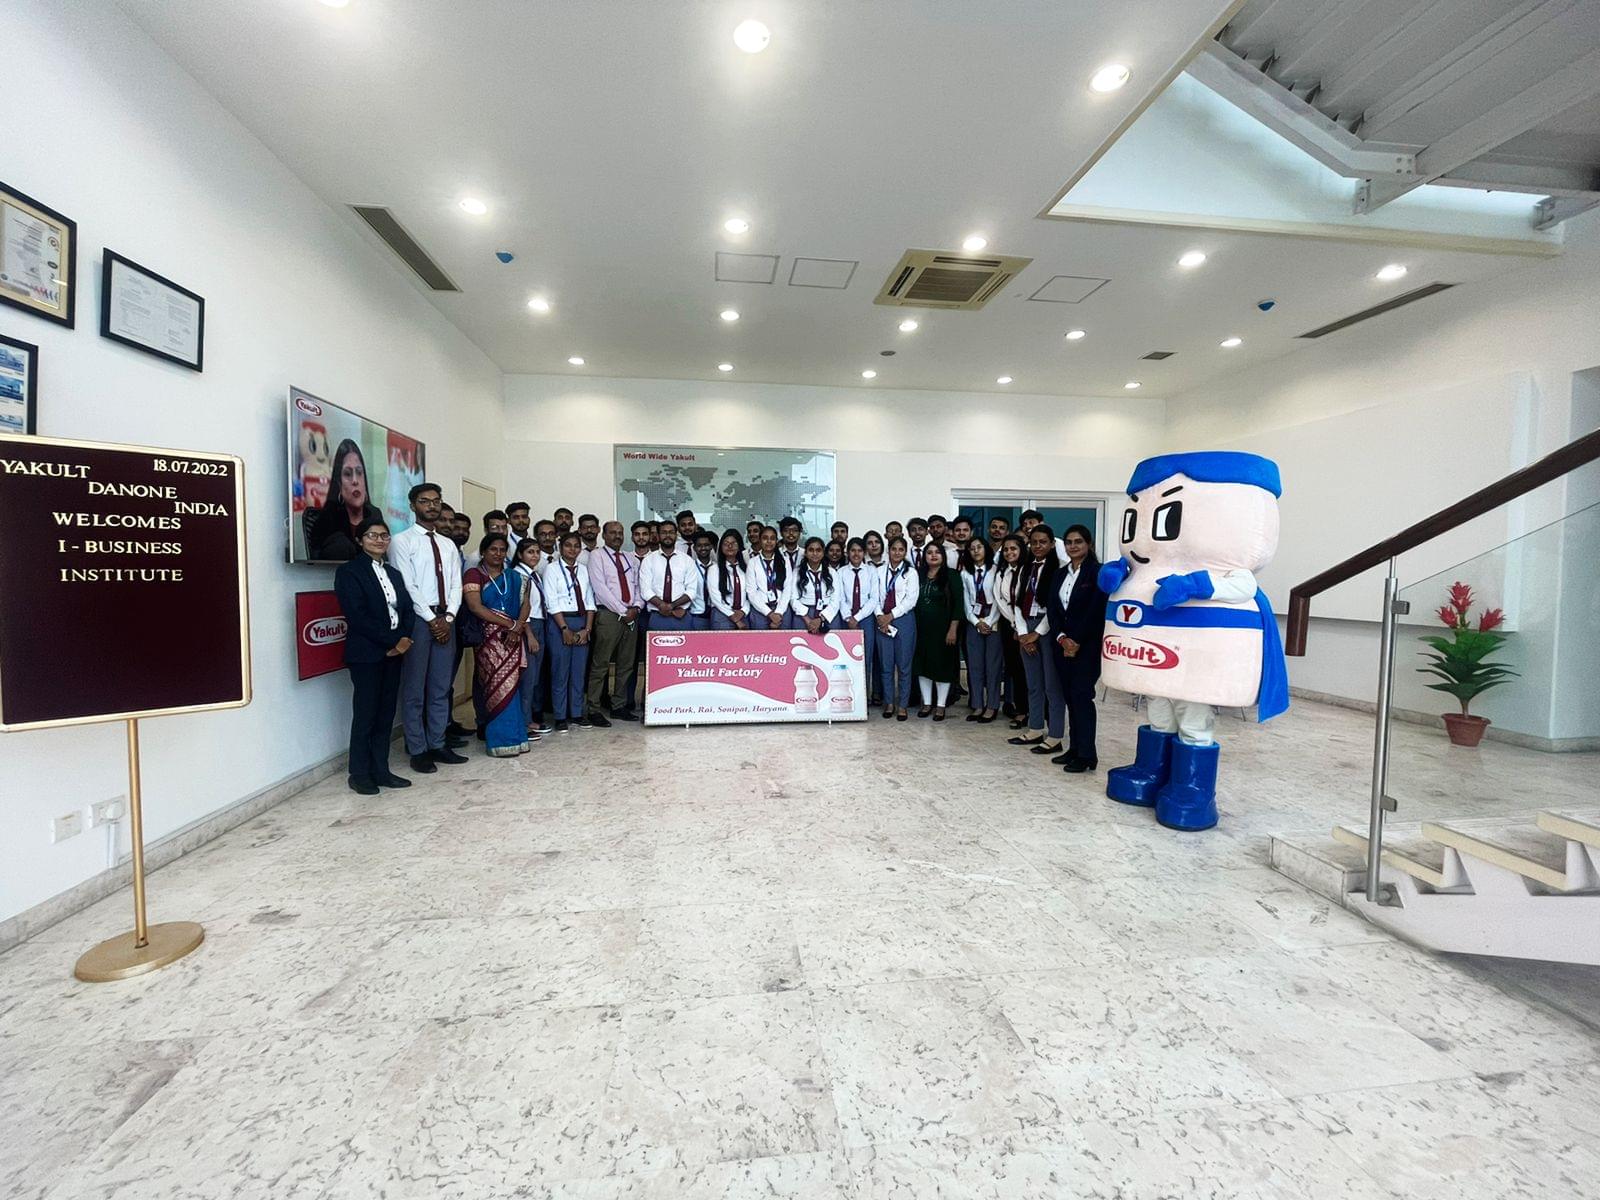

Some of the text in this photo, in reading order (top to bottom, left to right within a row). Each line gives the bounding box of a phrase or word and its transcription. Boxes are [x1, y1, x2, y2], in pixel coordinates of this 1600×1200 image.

[623, 452, 646, 460] World
[670, 453, 695, 461] Yakult
[0, 459, 91, 479] YAKULT
[153, 459, 228, 477] 18.07.2022
[88, 481, 178, 499] DANONE
[174, 501, 229, 517] INDIA
[52, 511, 182, 530] WELCOMES
[85, 540, 182, 555] BUSINESS
[60, 568, 184, 582] INSTITUTE
[1122, 605, 1137, 622] Y
[312, 623, 347, 638] Yakult
[655, 653, 788, 666] Thank You for Visiting
[1105, 641, 1160, 663] Yakult
[677, 667, 763, 679] Yakult Factory
